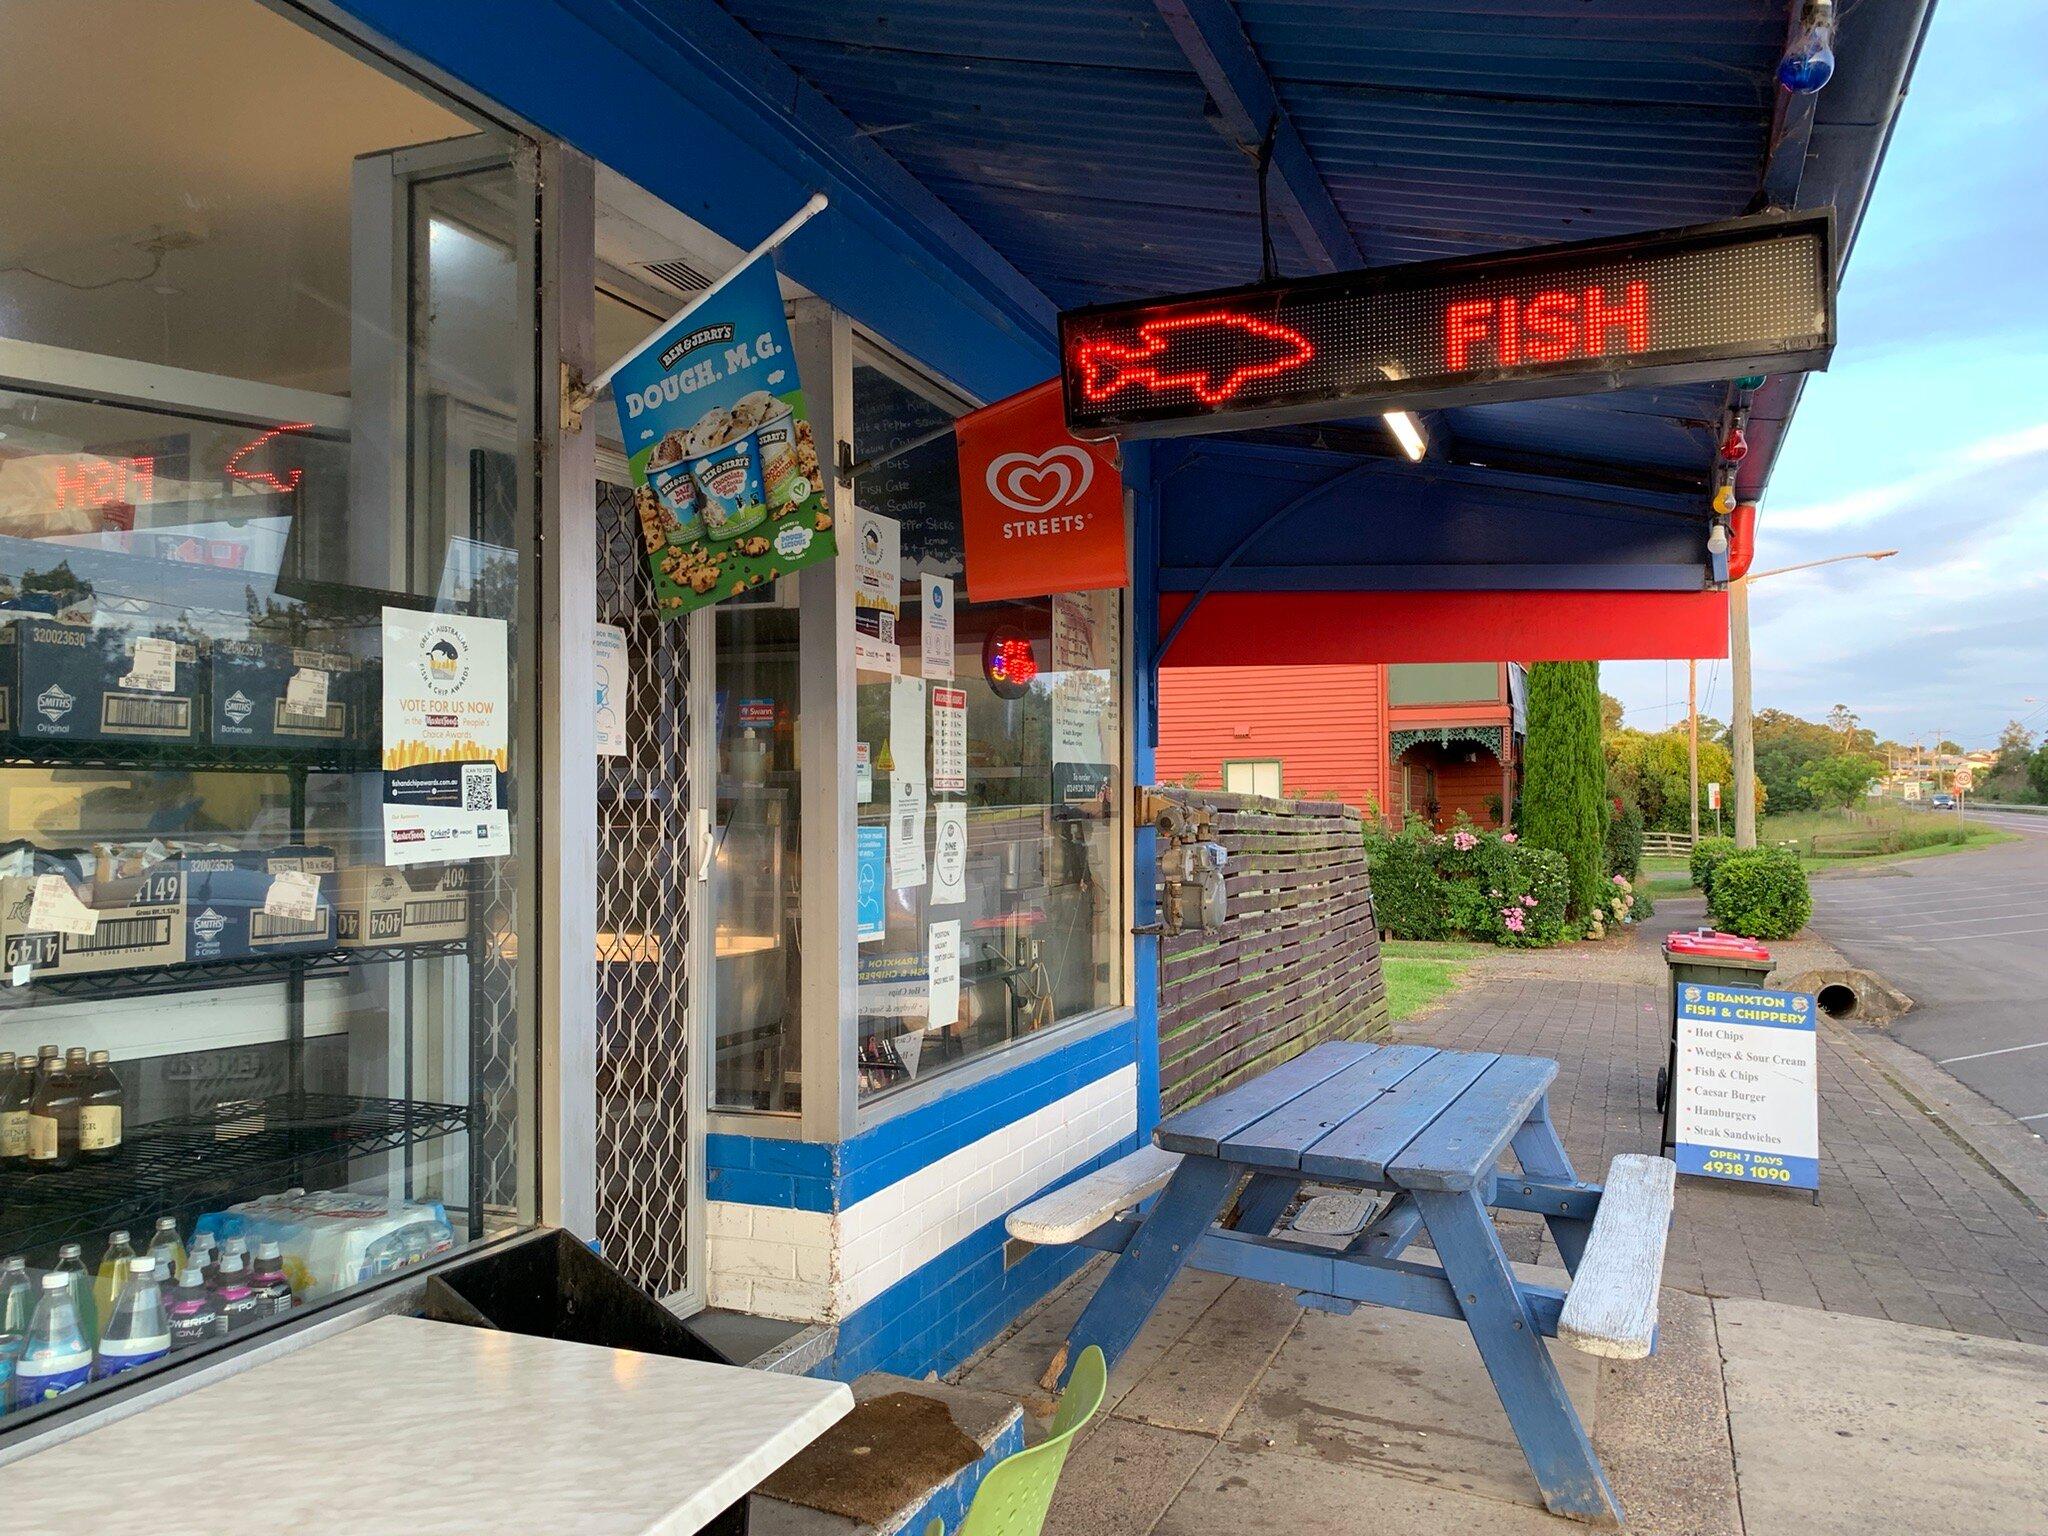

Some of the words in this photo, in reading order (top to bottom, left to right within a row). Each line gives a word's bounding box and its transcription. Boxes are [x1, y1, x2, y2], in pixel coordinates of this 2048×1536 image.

[1447, 279, 1649, 372] FISH
[626, 358, 723, 418] DOUGH.
[724, 332, 782, 375] M.G.
[1003, 514, 1085, 539] STREETS
[436, 626, 469, 652] AUSTRALIAN
[451, 666, 470, 695] AWARDS
[39, 696, 70, 709] SMITHS
[226, 700, 251, 712] SMITHS
[400, 699, 426, 712] VOTE
[429, 700, 449, 713] FOR
[452, 701, 465, 713] US
[467, 702, 494, 714] NOW
[37, 723, 70, 734] Original
[446, 731, 472, 739] Awards
[1958, 774, 1968, 782] 60
[194, 919, 222, 930] SMITHS
[371, 912, 402, 935] 4094
[6, 937, 57, 967] 4149
[1706, 992, 1786, 1008] BRANXTON
[1685, 1003, 1716, 1017] FISH
[1721, 1007, 1732, 1018] &
[1736, 1008, 1807, 1025] CHIPPERY
[1695, 1027, 1714, 1038] Hot
[1715, 1029, 1744, 1042] Chips
[1695, 1047, 1732, 1061] Wedges
[1734, 1050, 1744, 1061] &
[1746, 1051, 1770, 1063] Sour
[1772, 1054, 1807, 1067] Cream
[1695, 1066, 1716, 1077] Fish
[1718, 1068, 1728, 1079] &
[1730, 1069, 1759, 1082] Chips
[1694, 1085, 1729, 1098] Caesar
[1731, 1089, 1767, 1104] Burger
[1694, 1105, 1757, 1122] Hamburgers
[1694, 1124, 1721, 1138] Steak
[1723, 1128, 1782, 1145] Sandwiches
[1709, 1149, 1742, 1161] OPEN
[1744, 1152, 1751, 1162] 7
[1754, 1154, 1784, 1166] DAYS
[1703, 1161, 1745, 1177] 4938
[1750, 1165, 1791, 1182] 1090
[168, 1312, 216, 1329] OWERADE
